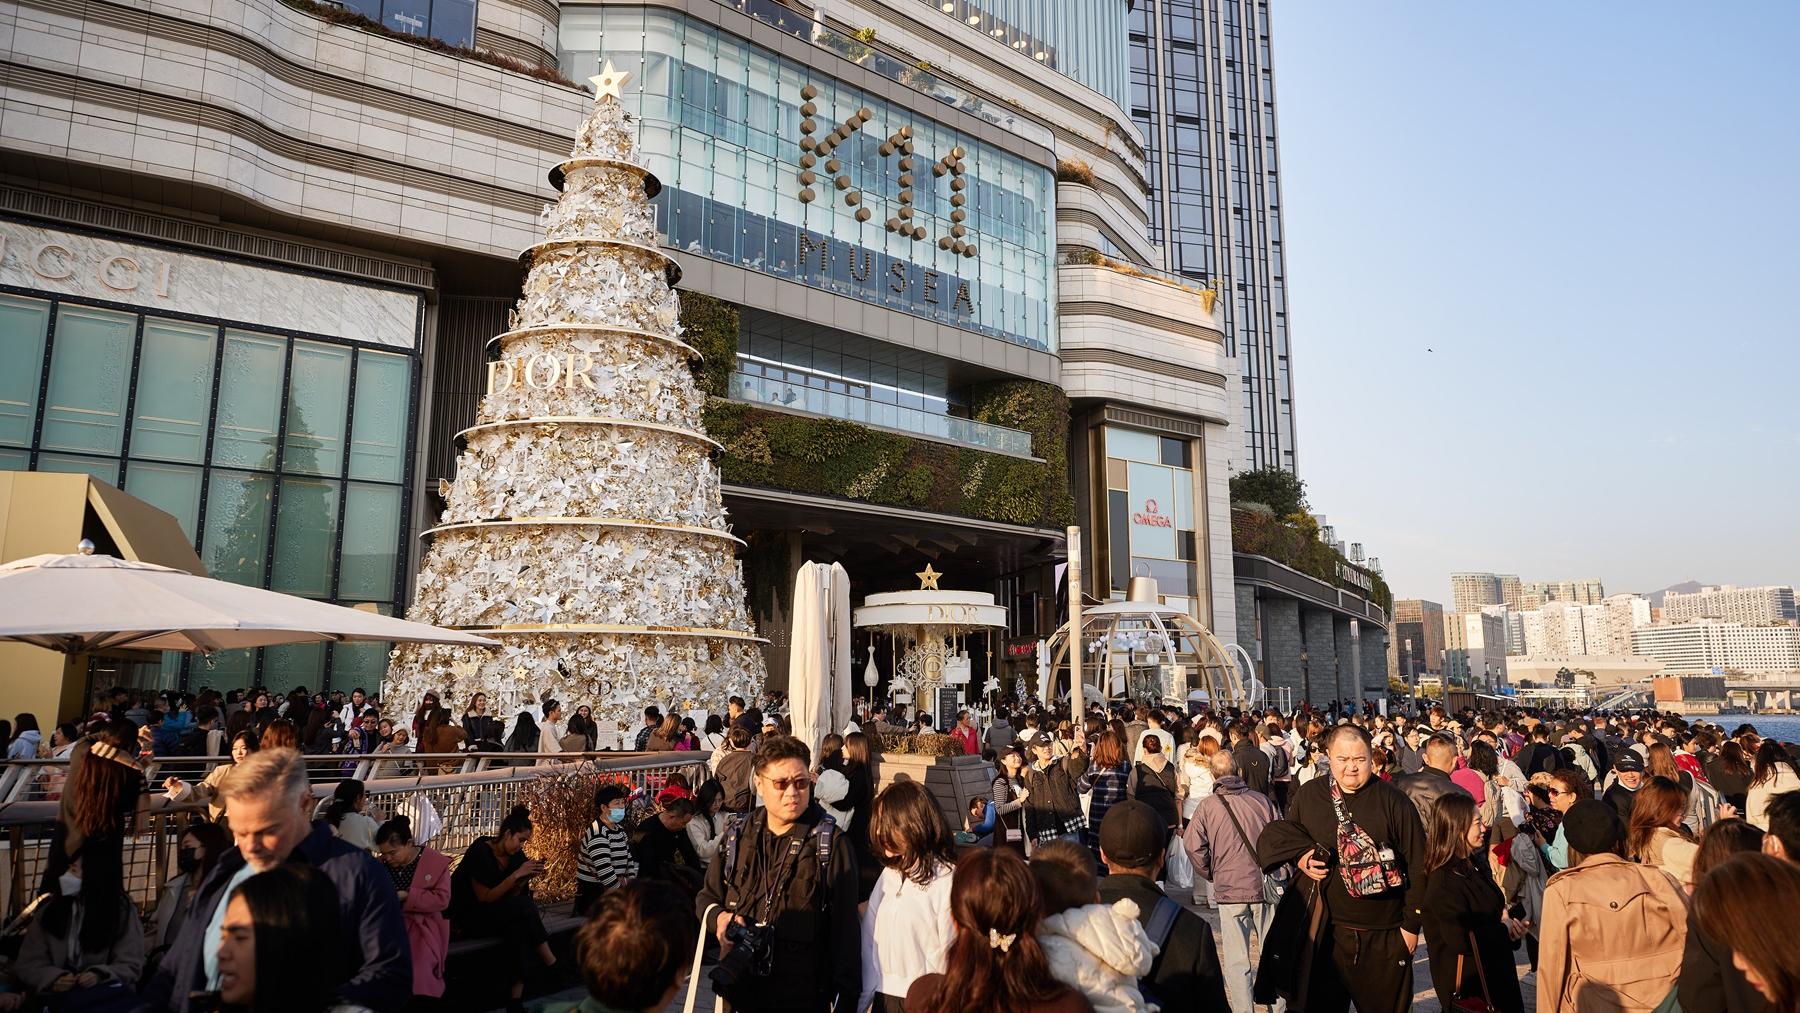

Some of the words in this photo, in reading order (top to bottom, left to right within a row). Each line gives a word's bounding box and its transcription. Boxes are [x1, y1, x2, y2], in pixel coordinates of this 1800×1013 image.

[799, 84, 978, 259] K11
[0, 233, 171, 298] CCI
[800, 232, 975, 314] MUSEA
[486, 352, 599, 396] DIOR
[1133, 512, 1172, 528] OMEGA
[928, 605, 979, 623] DIOR
[763, 629, 792, 648] K1
